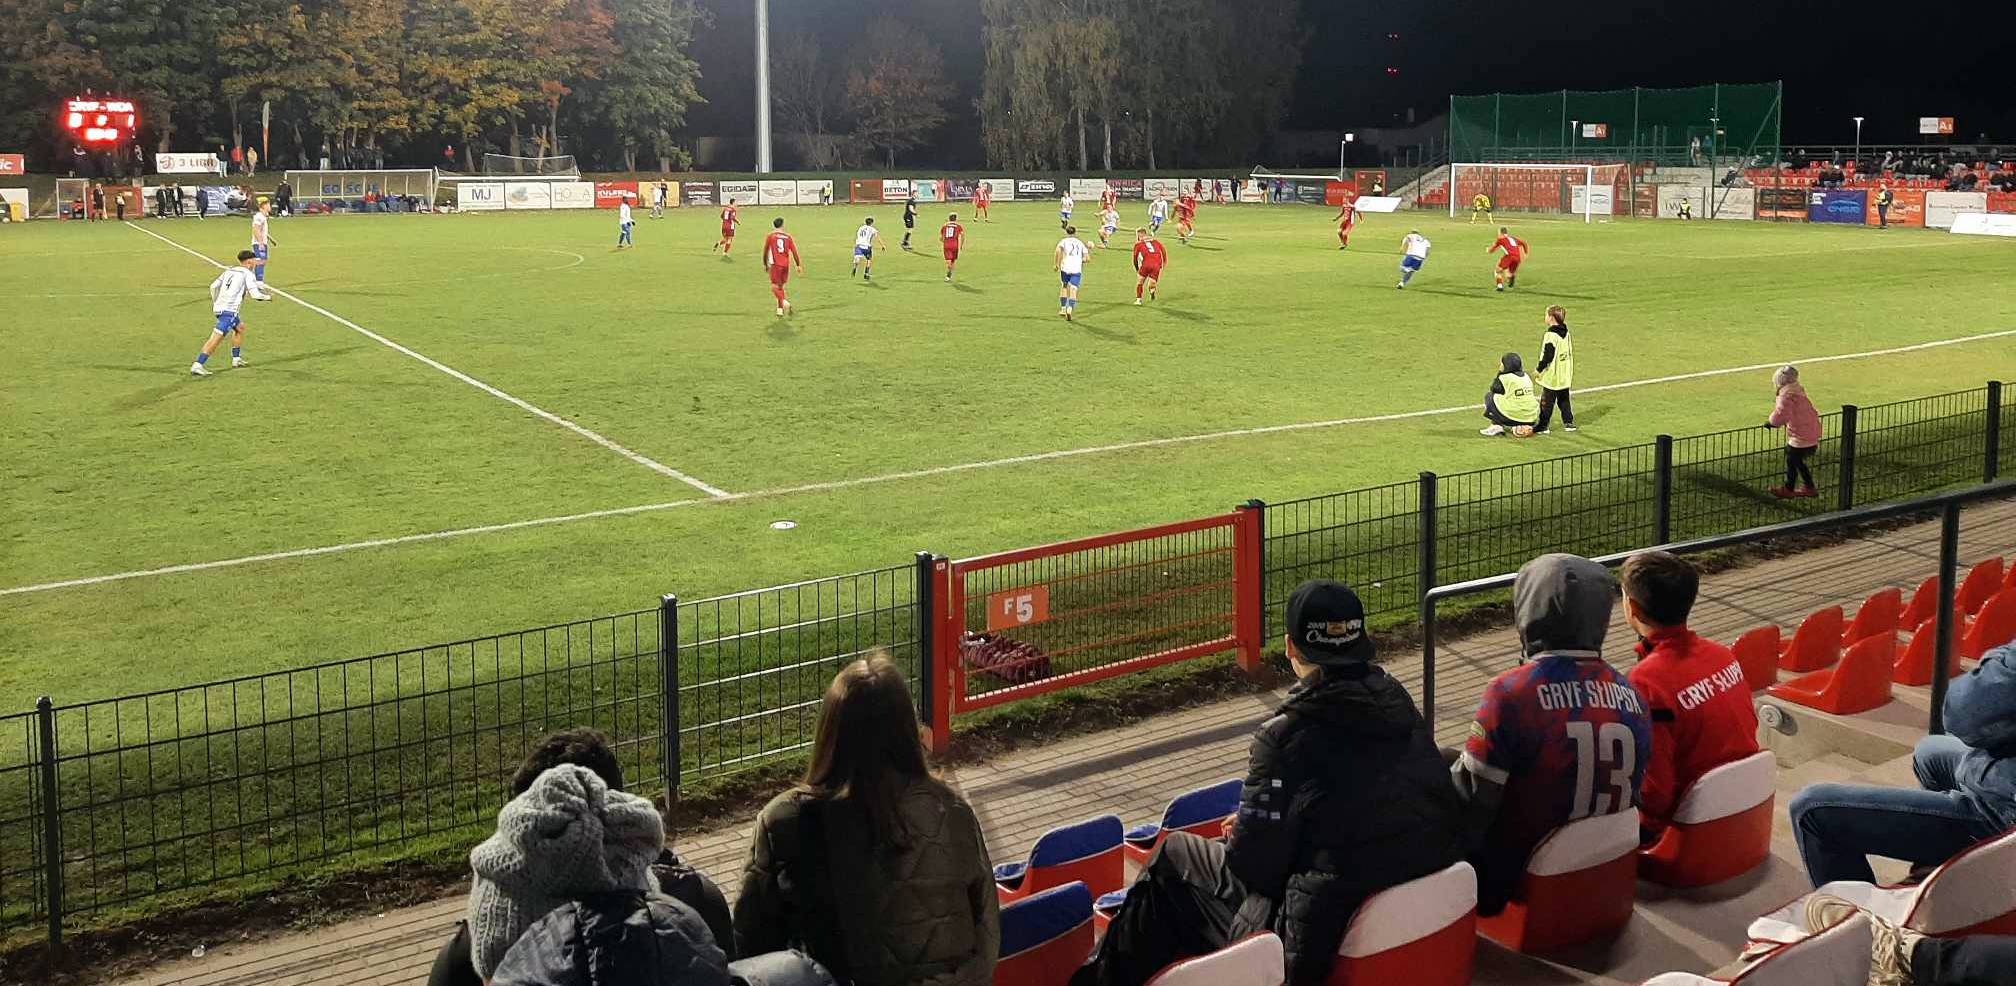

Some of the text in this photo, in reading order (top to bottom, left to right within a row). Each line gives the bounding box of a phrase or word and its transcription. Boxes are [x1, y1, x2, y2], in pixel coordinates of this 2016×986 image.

[471, 188, 492, 201] MJ
[722, 185, 748, 193] EGIDA
[776, 238, 785, 253] 9
[225, 274, 233, 290] 4
[1536, 679, 1643, 716] GRYF SŁUPSK
[1676, 677, 1715, 711] GRYF
[1566, 720, 1636, 820] 13
